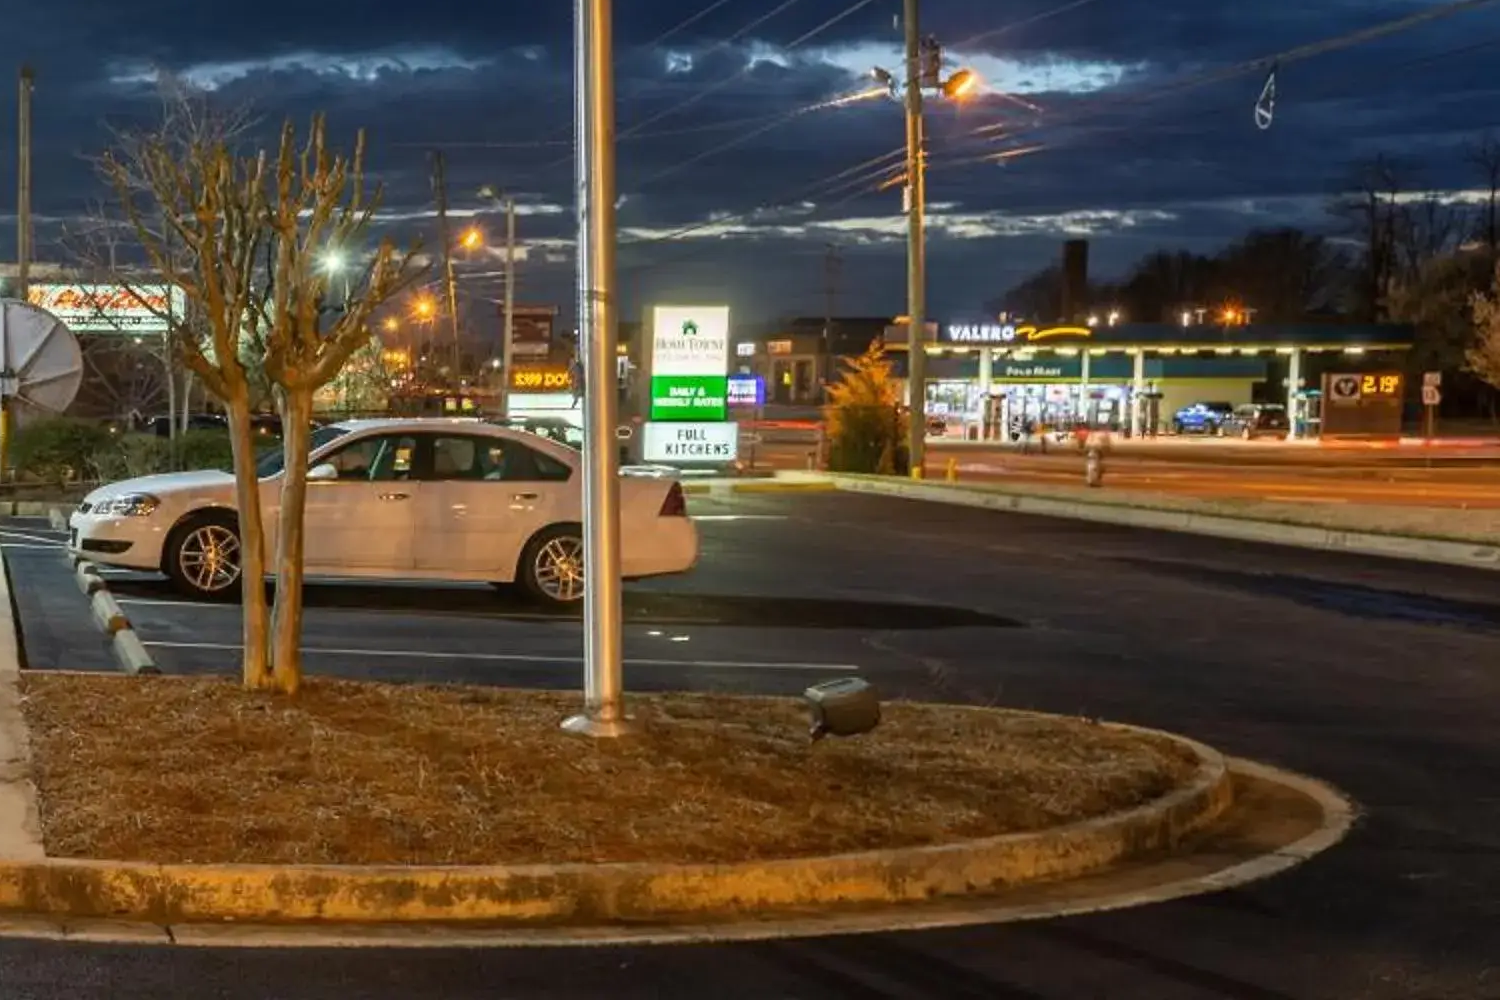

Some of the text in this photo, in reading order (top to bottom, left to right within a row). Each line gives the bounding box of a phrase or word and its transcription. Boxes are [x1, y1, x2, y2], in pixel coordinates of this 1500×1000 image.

[949, 325, 1015, 341] VALERO
[677, 430, 707, 441] FULL
[665, 443, 730, 455] KITCHENS
